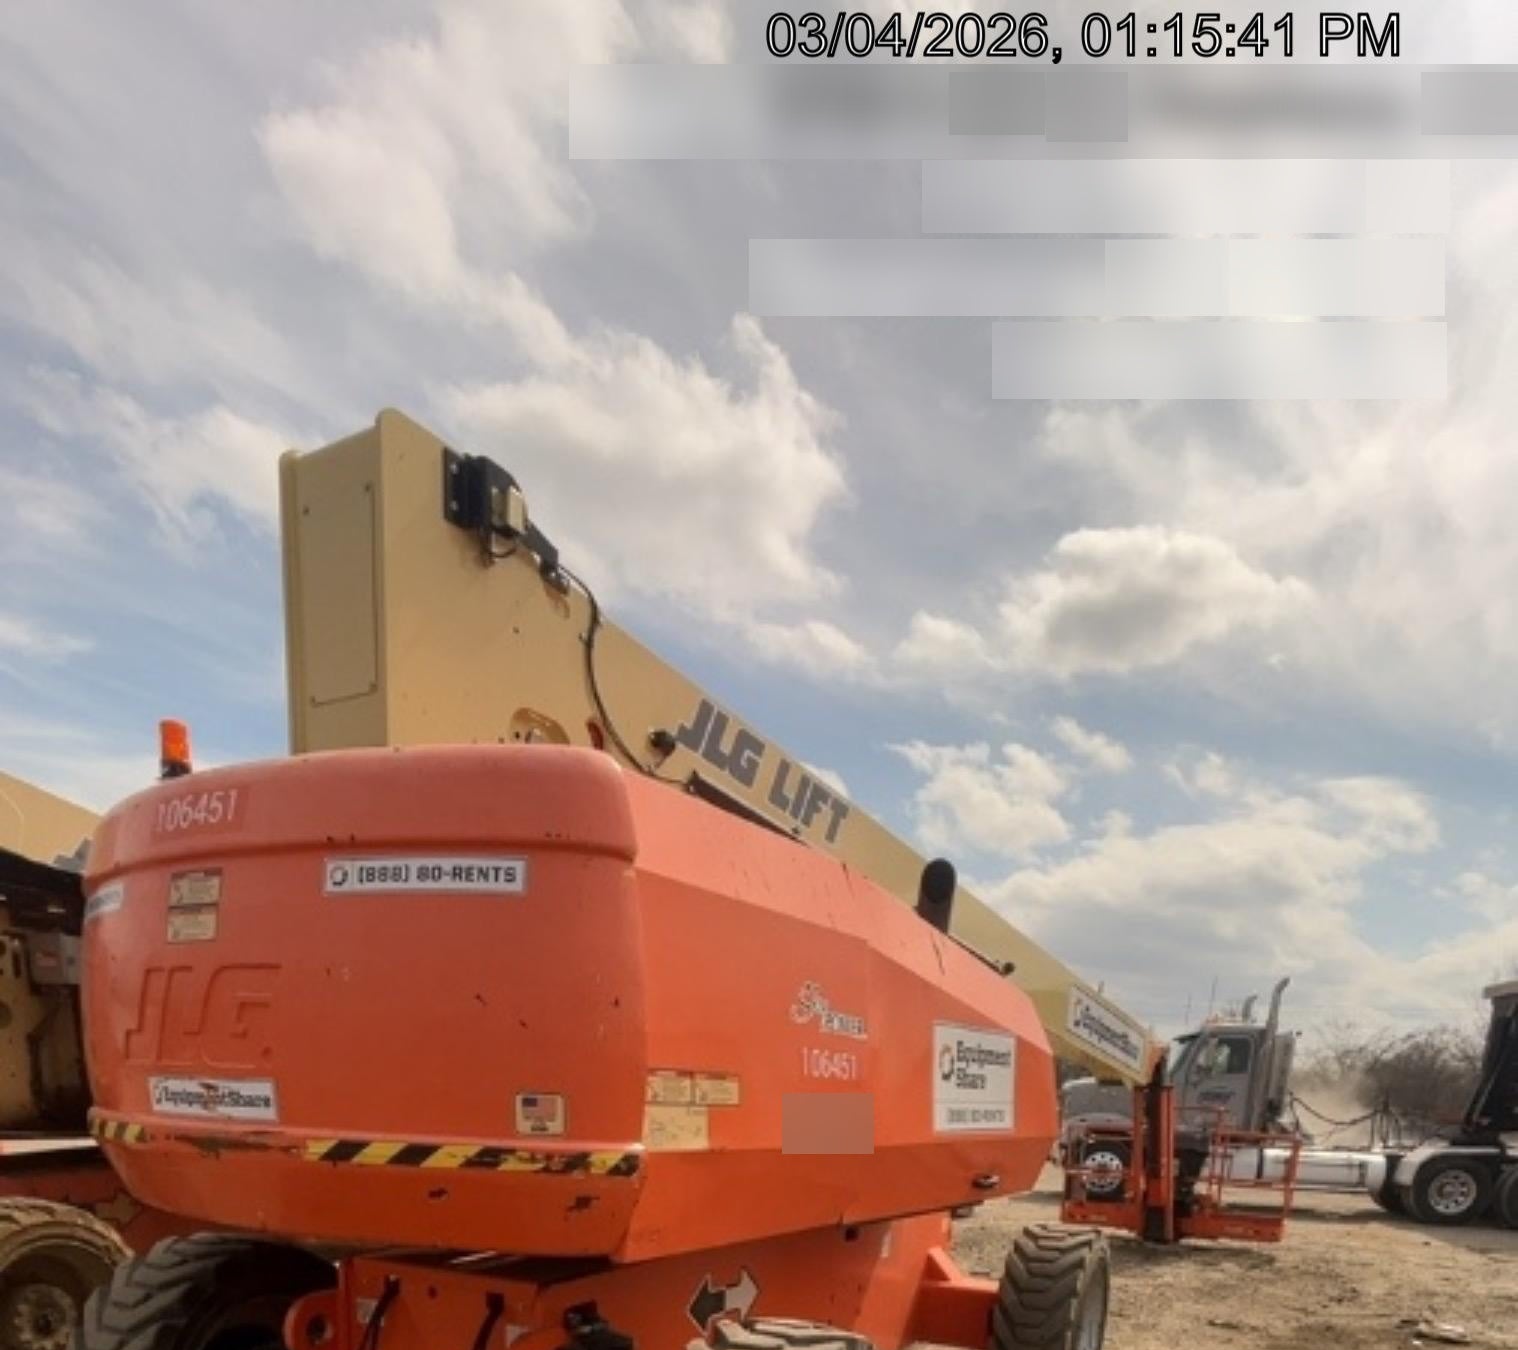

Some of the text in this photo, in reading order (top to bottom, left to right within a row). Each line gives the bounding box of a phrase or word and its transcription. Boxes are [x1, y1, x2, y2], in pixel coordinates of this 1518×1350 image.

[676, 698, 849, 844] JLG LIFT
[157, 789, 238, 833] 106451
[416, 865, 517, 883] 80-RENTS
[803, 1047, 857, 1079] 106451
